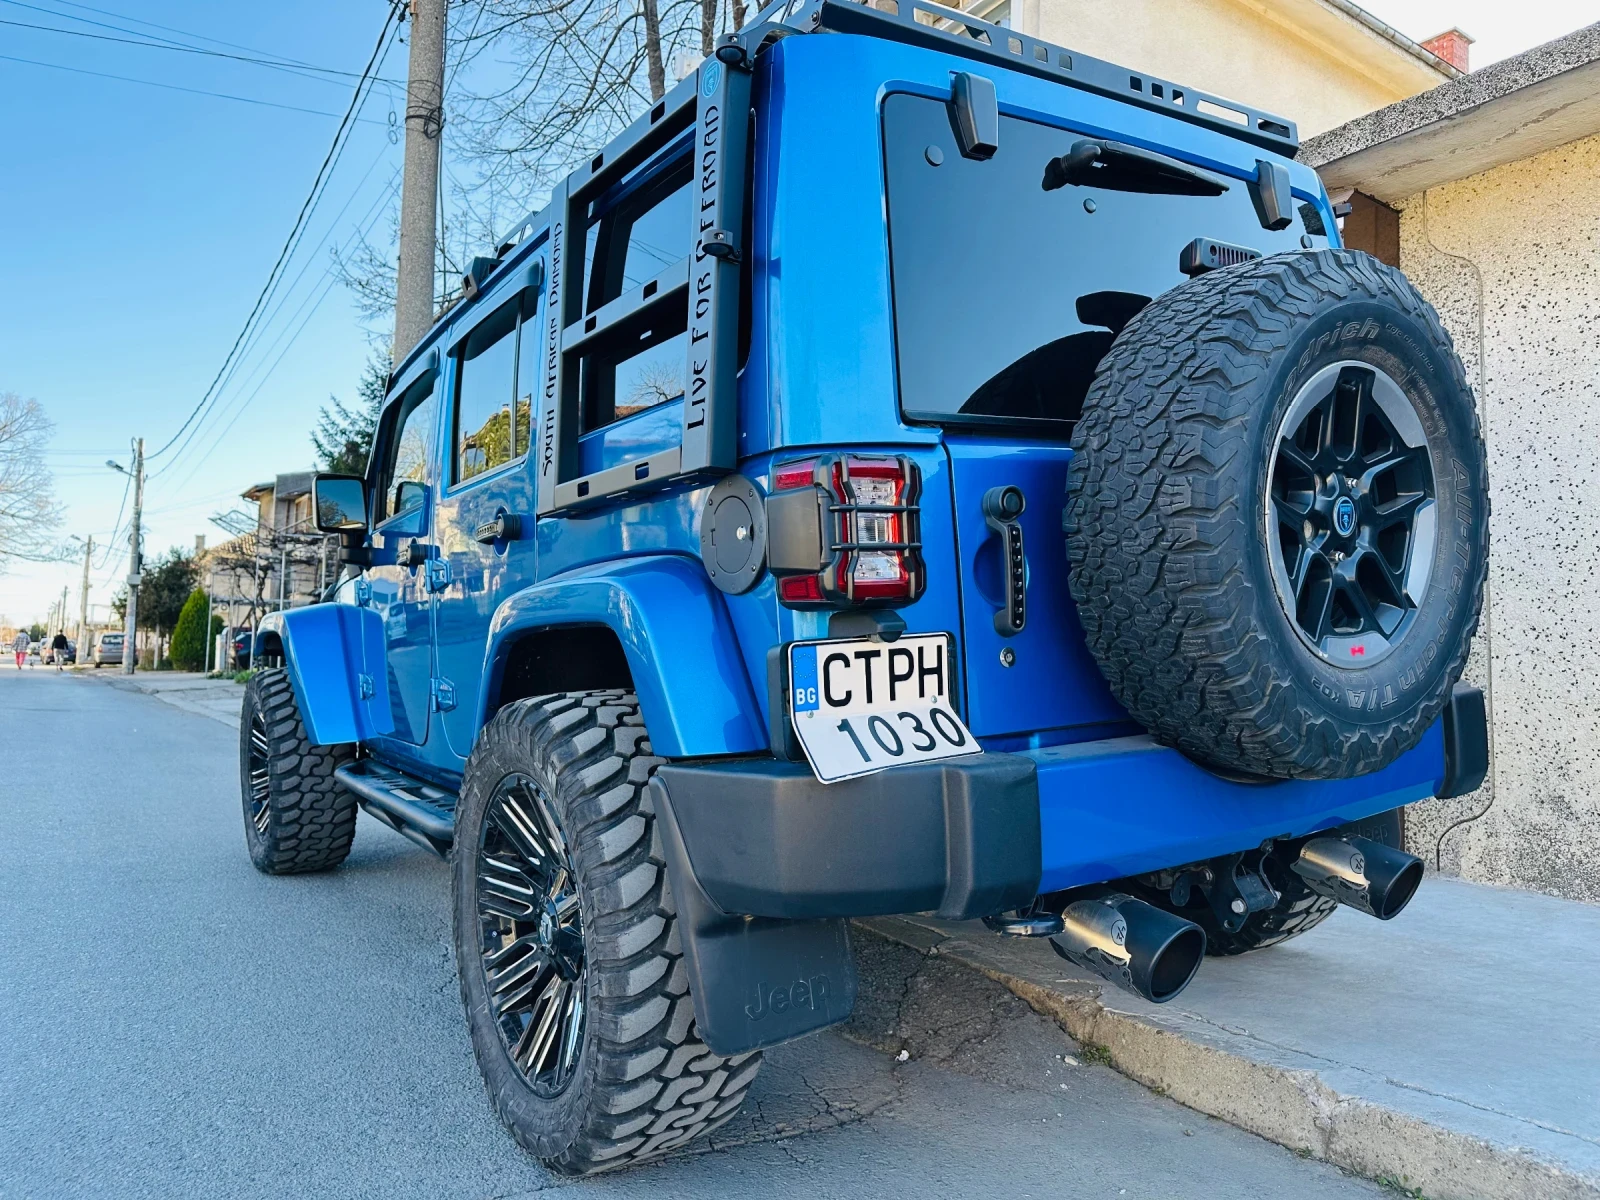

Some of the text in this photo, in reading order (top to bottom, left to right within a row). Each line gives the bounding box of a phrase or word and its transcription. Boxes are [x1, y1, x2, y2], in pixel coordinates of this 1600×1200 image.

[692, 271, 711, 347] FOR
[542, 221, 563, 478] SOUTH AFRICAN DIAMOND
[1404, 332, 1436, 373] Champion
[687, 358, 708, 431] LIVE
[1398, 457, 1473, 692] All-Terrain
[795, 687, 817, 706] BG
[1346, 683, 1399, 712] T/A
[836, 707, 966, 763] 1030
[744, 973, 832, 1022] Jeep
